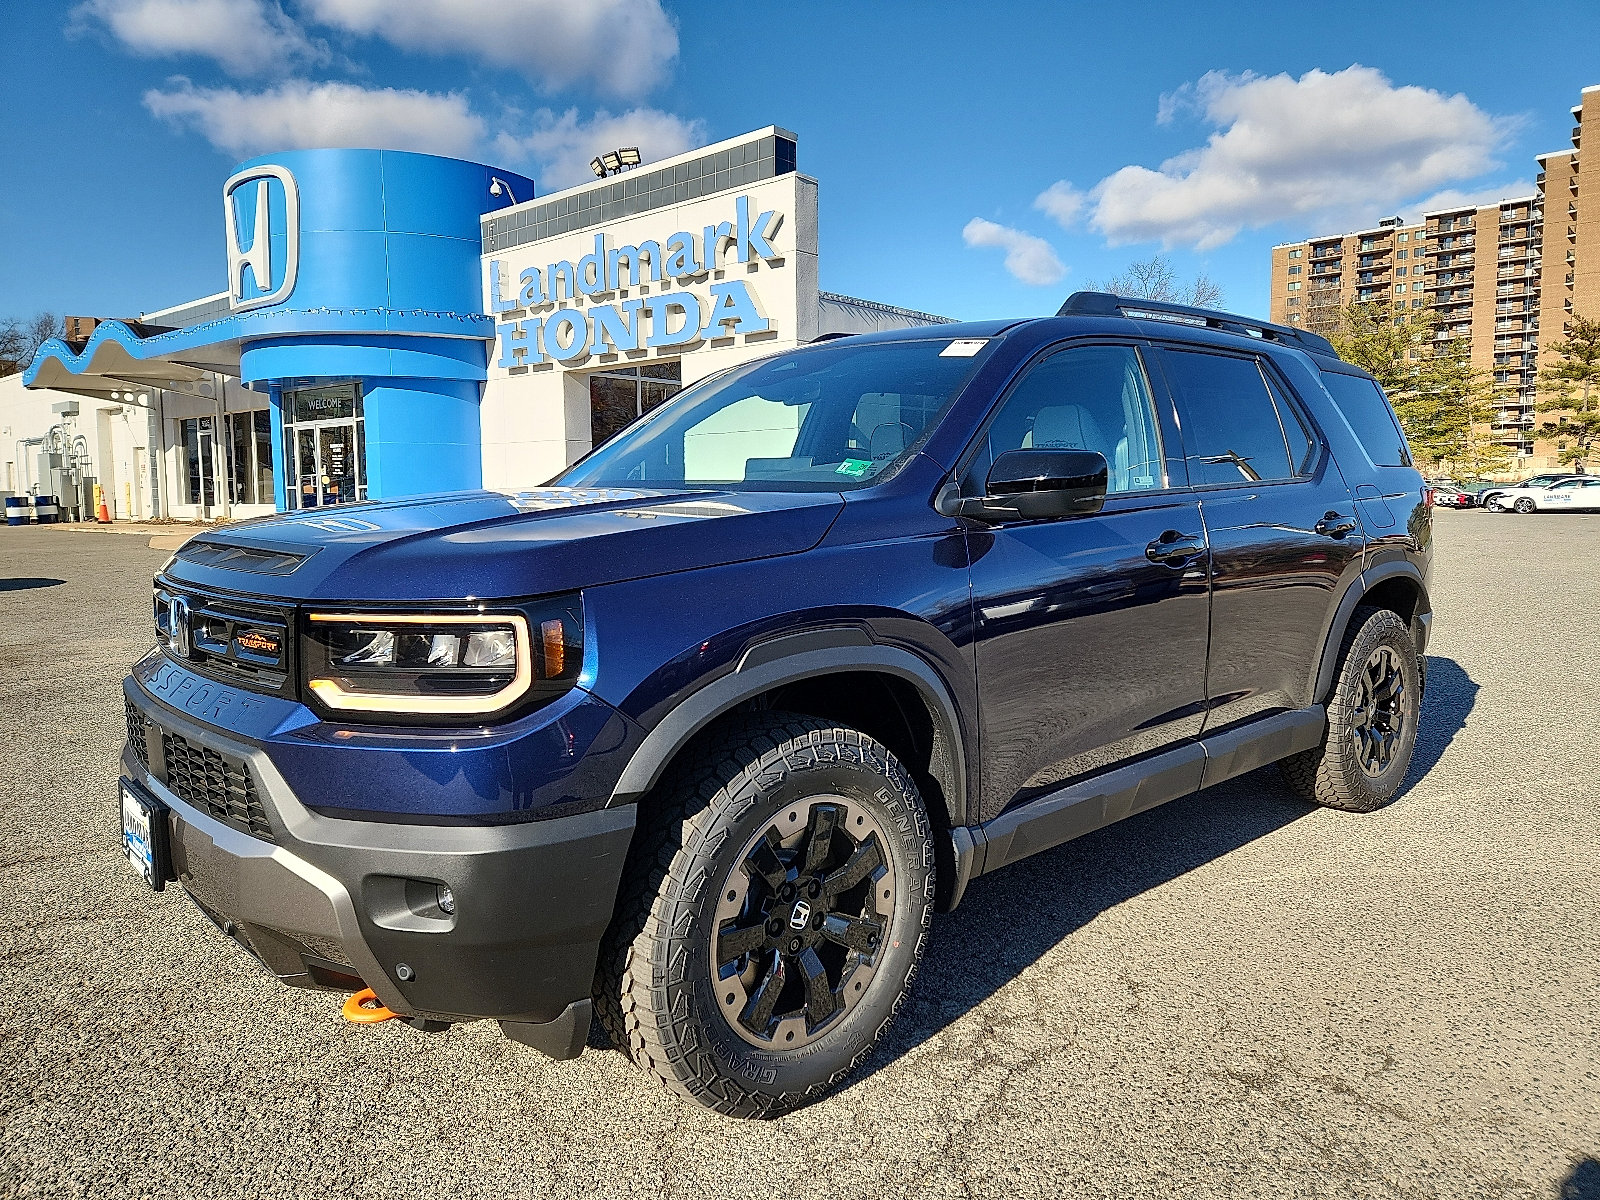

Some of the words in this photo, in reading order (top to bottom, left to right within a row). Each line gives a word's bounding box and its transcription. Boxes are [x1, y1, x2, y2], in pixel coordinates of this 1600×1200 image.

[490, 195, 783, 314] Landmark
[498, 280, 773, 369] HONDA
[308, 398, 342, 411] WELCOME
[874, 786, 921, 913] GENERAL
